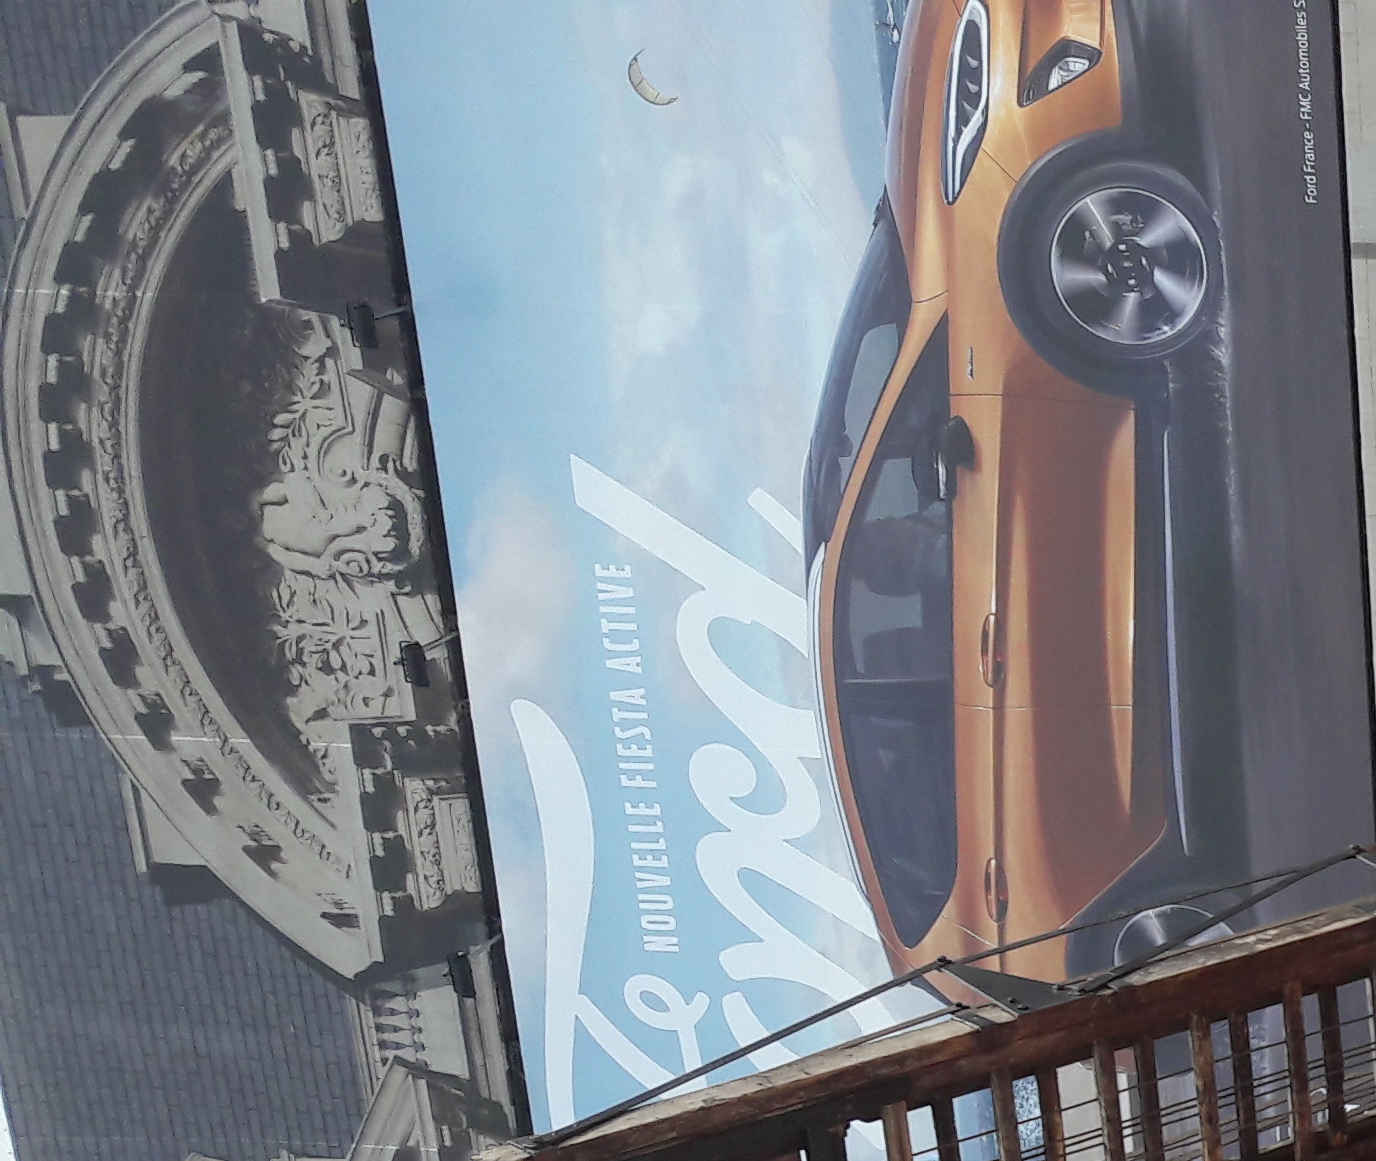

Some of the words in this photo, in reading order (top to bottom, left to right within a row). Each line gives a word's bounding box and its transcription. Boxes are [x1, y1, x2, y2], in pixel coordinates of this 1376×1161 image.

[1294, 11, 1312, 91] Automobiles
[1298, 92, 1313, 120] FMC
[1301, 131, 1316, 173] France
[1303, 175, 1318, 204] Ford
[594, 562, 644, 674] ACTIVE
[608, 686, 658, 789] FIESTA
[623, 800, 680, 952] NOUVELLE
